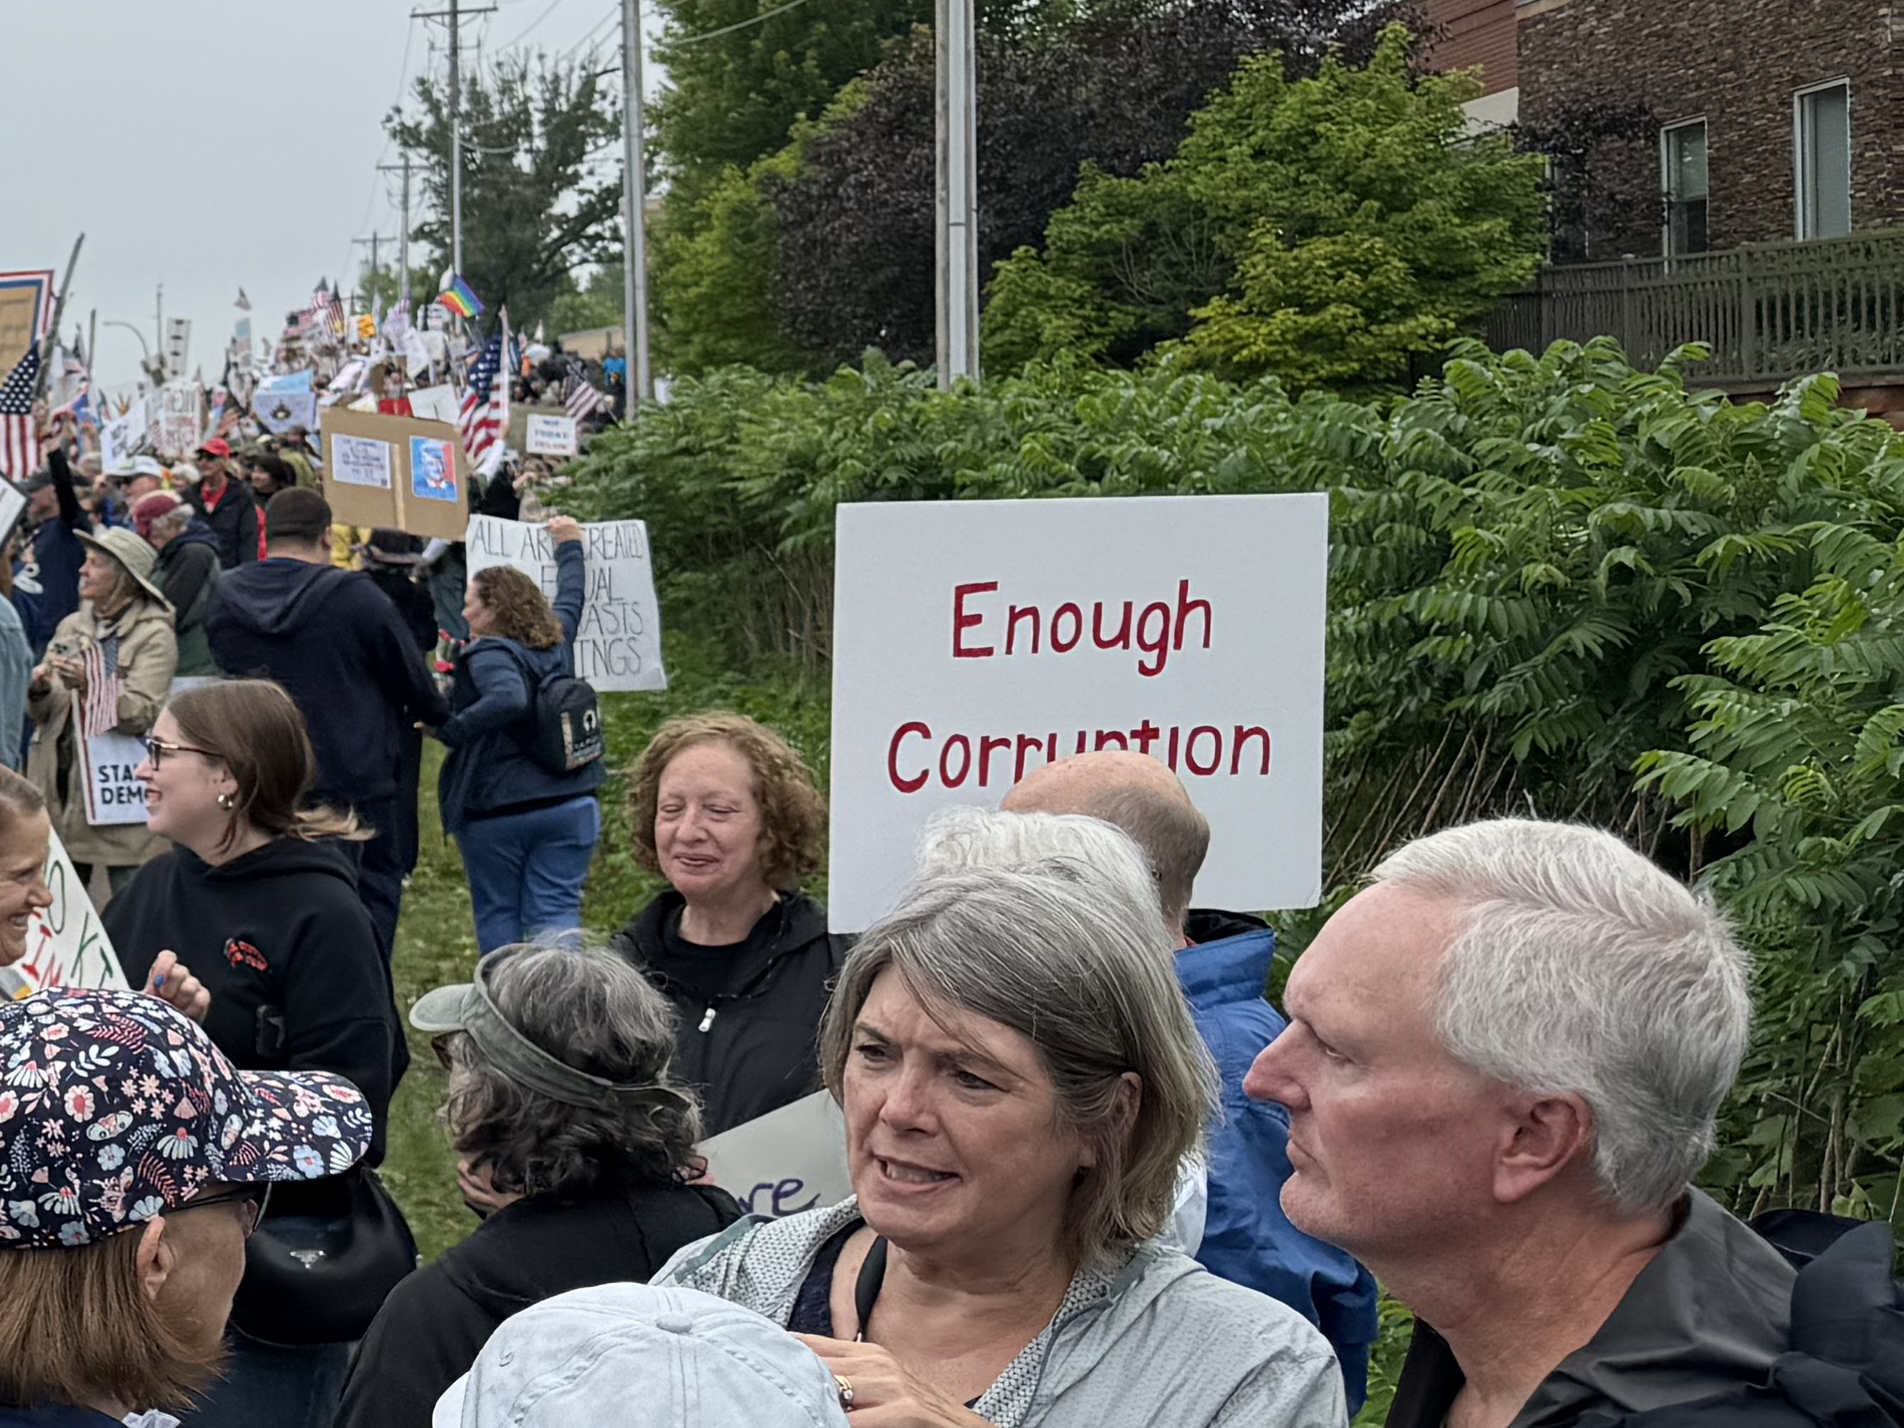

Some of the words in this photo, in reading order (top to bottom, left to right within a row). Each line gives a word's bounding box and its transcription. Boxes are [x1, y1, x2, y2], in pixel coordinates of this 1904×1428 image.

[469, 520, 513, 558] ALL
[520, 525, 556, 562] AR
[581, 523, 643, 561] REATED
[952, 578, 1212, 677] Enough
[575, 636, 642, 678] INGS
[97, 763, 139, 783] STA
[888, 719, 1272, 794] Corrtion
